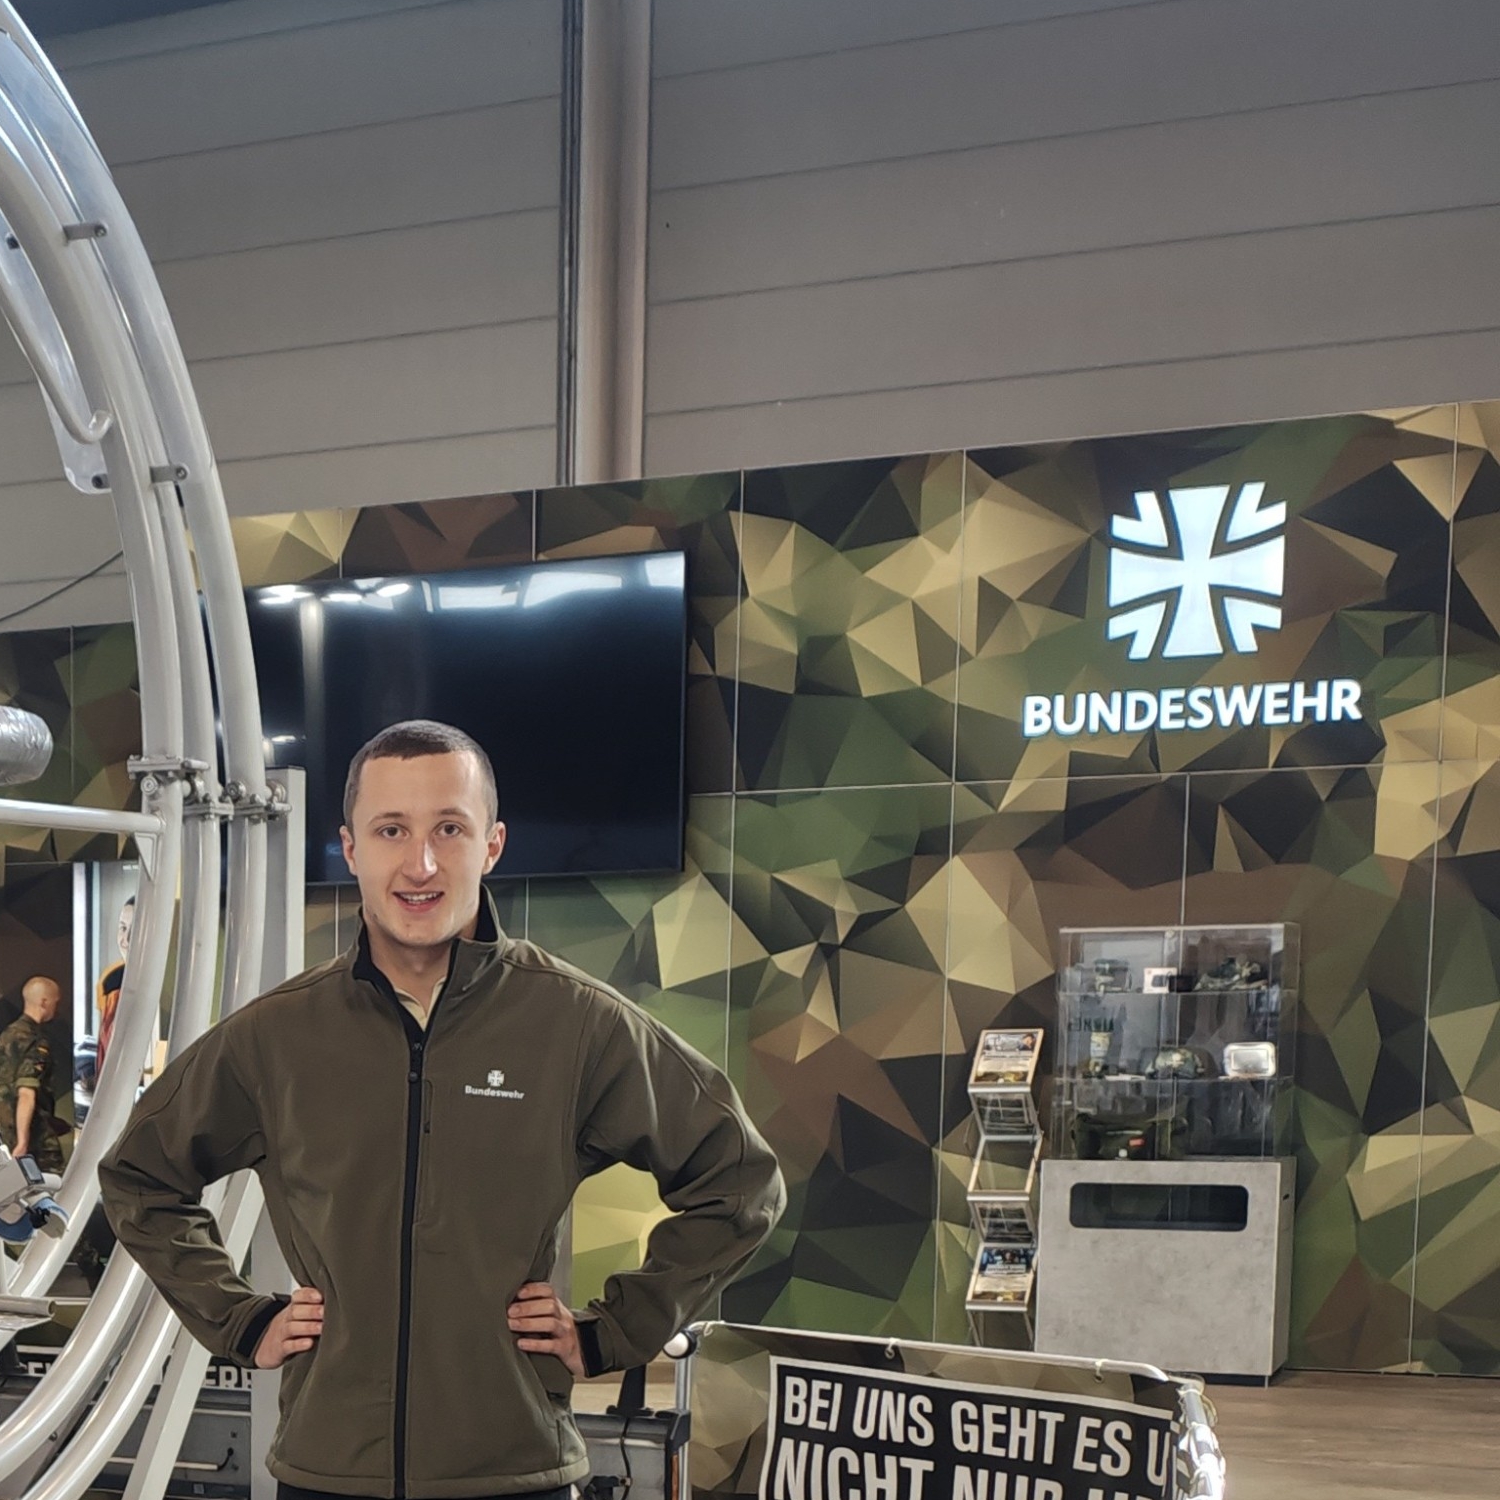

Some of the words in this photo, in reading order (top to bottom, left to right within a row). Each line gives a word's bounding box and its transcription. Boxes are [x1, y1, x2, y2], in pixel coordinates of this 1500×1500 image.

[1023, 678, 1363, 737] BUNDESWEHR
[465, 1085, 525, 1100] Bundeswehr
[784, 1376, 843, 1433] BEI
[852, 1387, 934, 1447] UNS
[951, 1401, 1065, 1466] GEHT
[1073, 1416, 1132, 1477] ES
